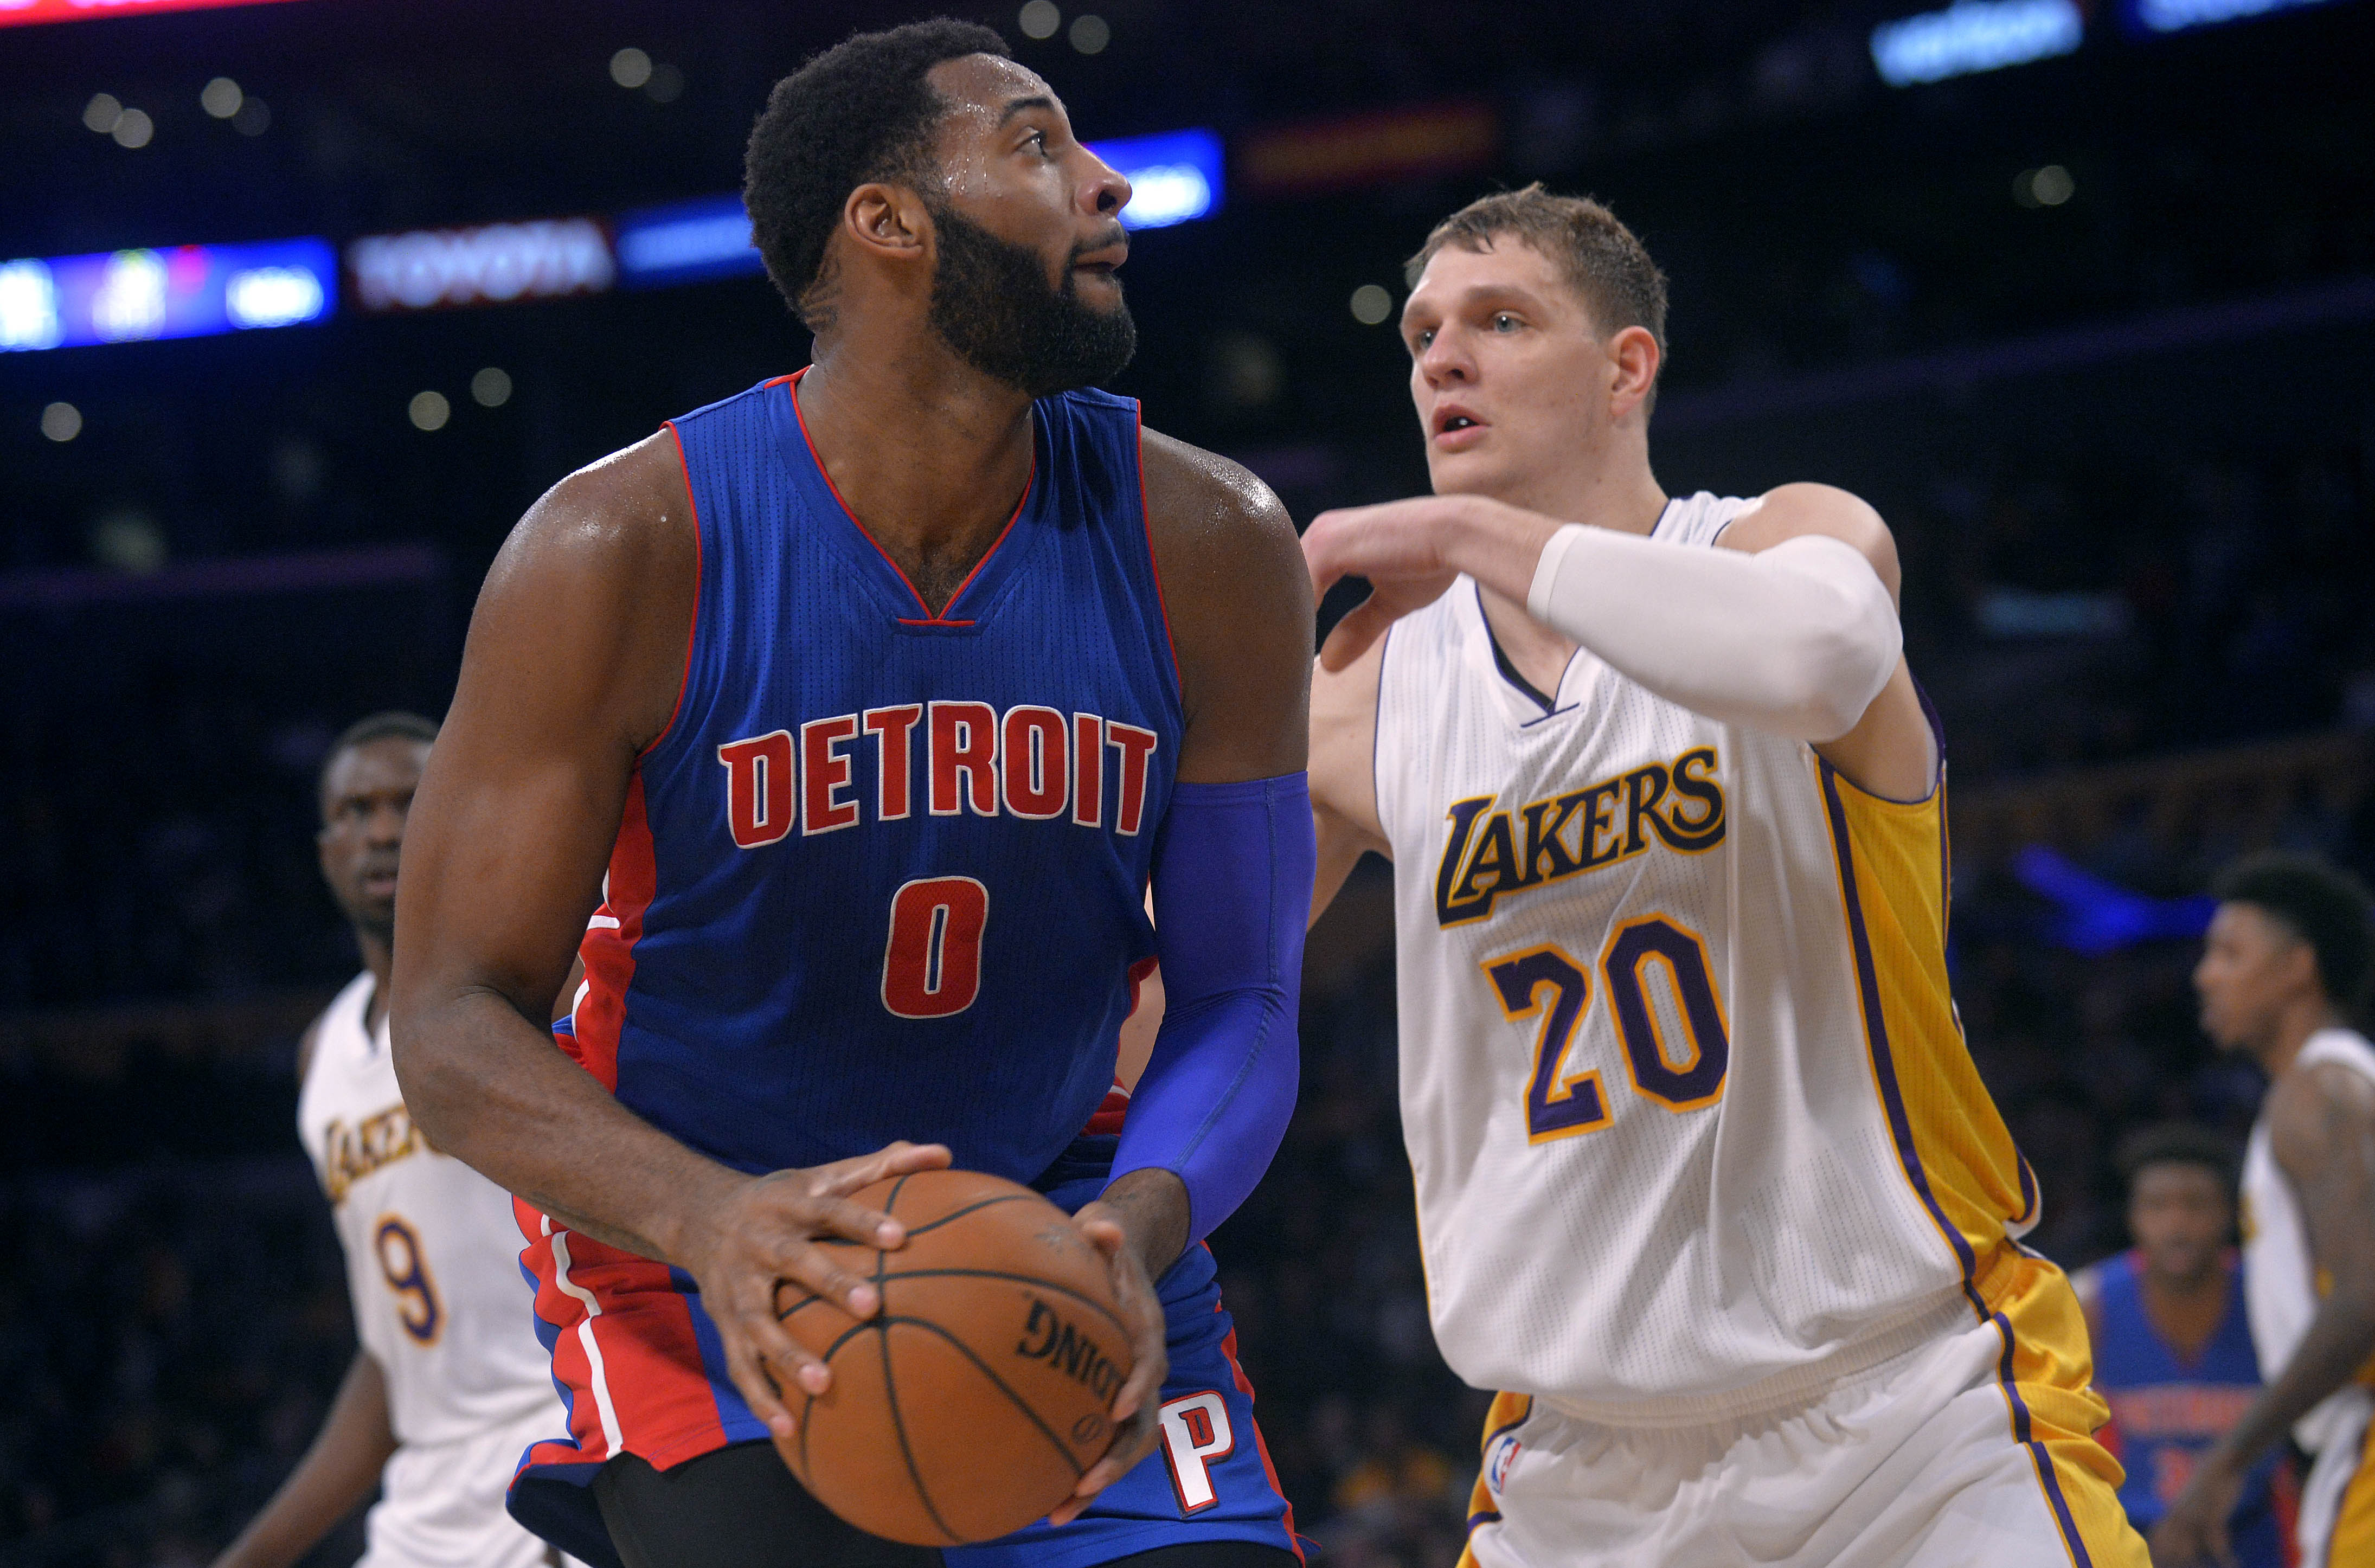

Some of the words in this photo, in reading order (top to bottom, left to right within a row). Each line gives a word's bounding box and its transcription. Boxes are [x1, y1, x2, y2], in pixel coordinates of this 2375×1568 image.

[717, 699, 1158, 849] DETROIT
[1436, 745, 1726, 930] LAKERS
[881, 876, 989, 1019] 0
[1479, 911, 1730, 1146] 20
[374, 1212, 449, 1351] 9
